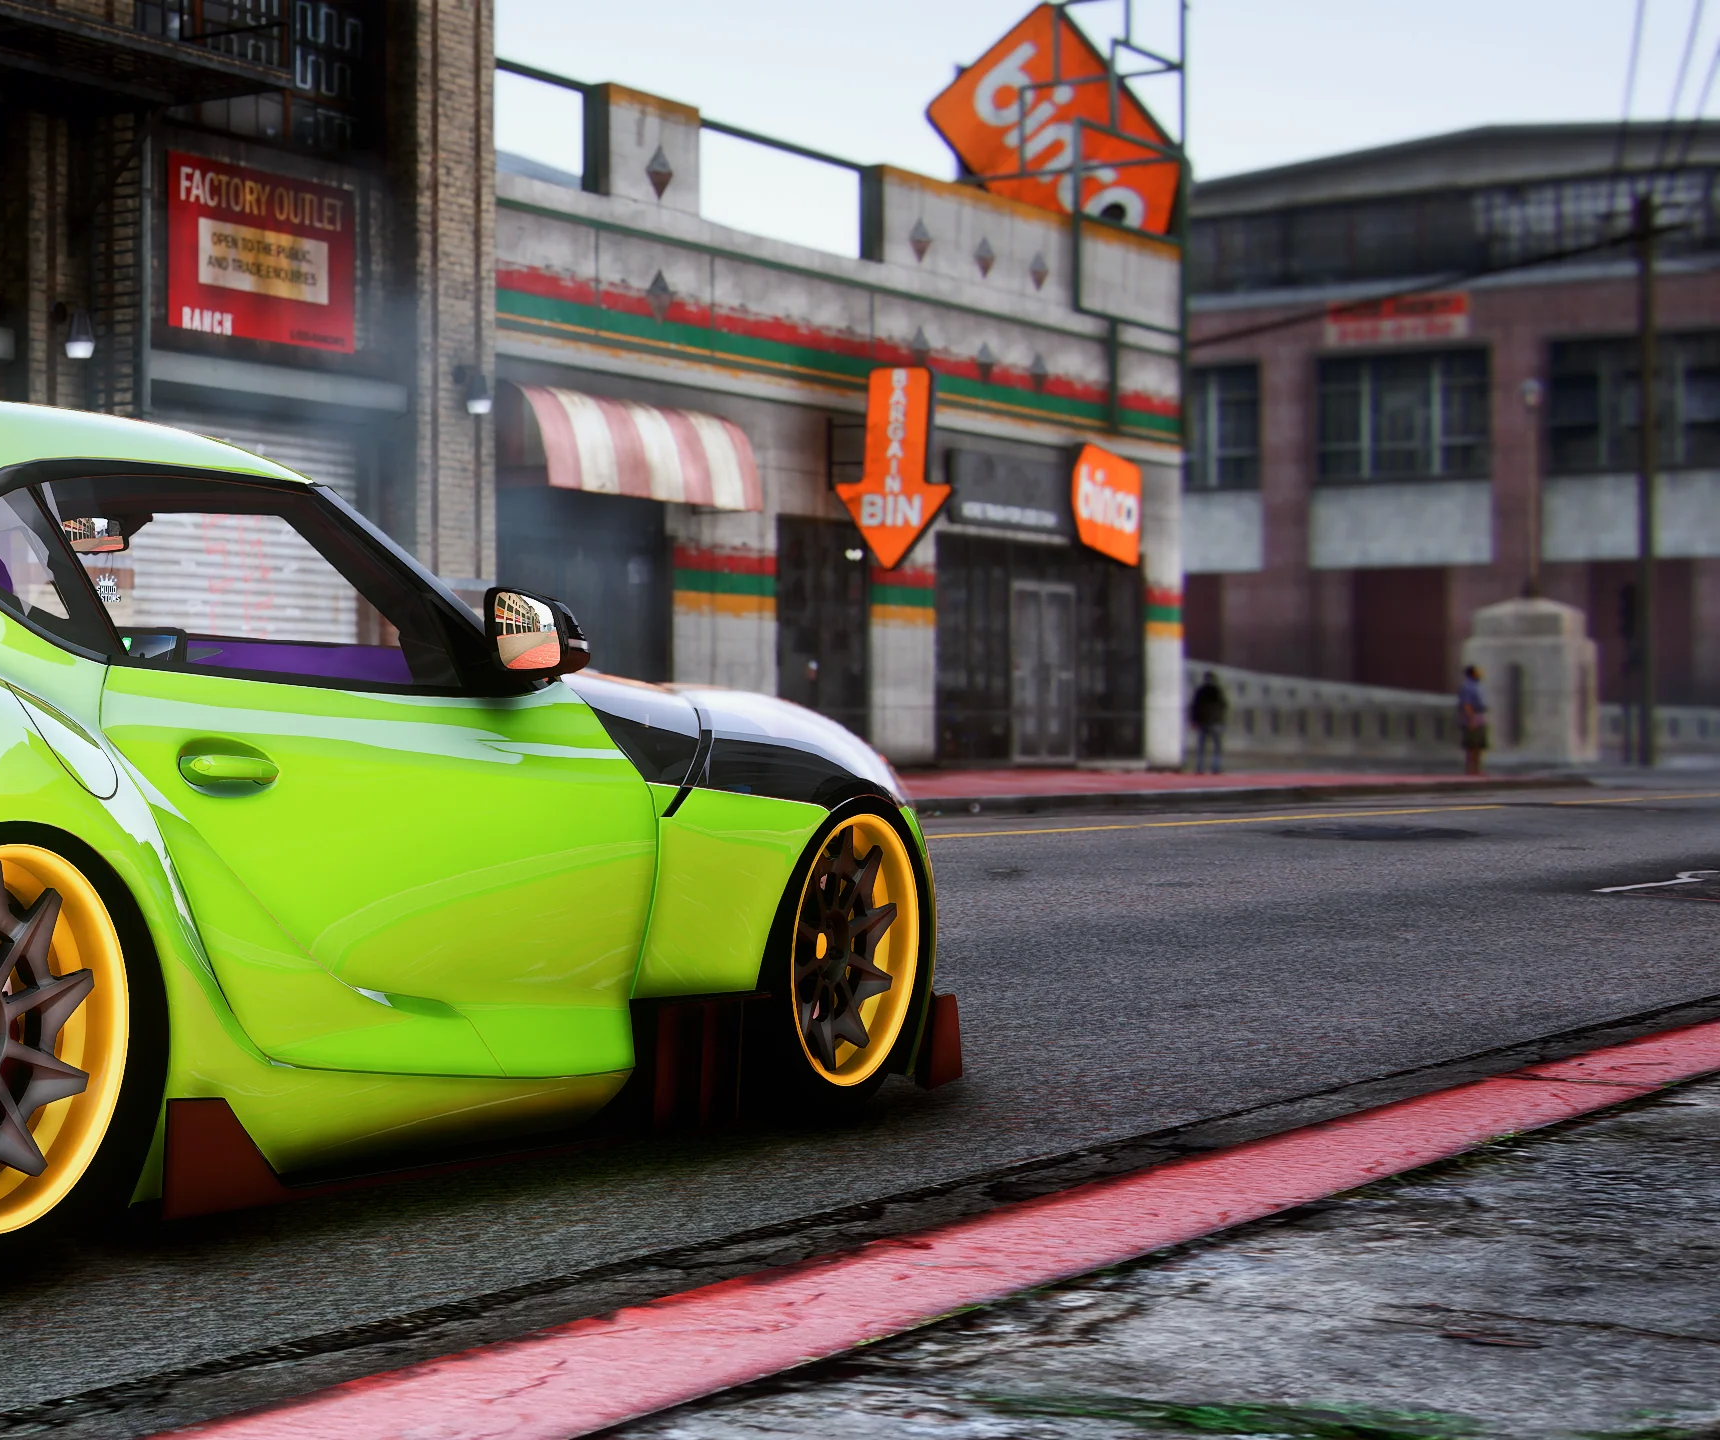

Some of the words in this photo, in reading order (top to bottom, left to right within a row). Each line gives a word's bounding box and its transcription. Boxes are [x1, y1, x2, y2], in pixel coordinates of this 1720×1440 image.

[974, 41, 1146, 228] binco
[180, 166, 271, 217] FACTORY
[274, 186, 344, 232] OUTLET
[206, 254, 230, 271] AND
[231, 258, 263, 278] TRADE
[211, 232, 238, 250] OPEN
[241, 237, 255, 252] TO
[255, 240, 273, 256] THE
[181, 306, 233, 336] RANCH
[884, 368, 908, 494] BARGAIN
[860, 493, 922, 527] BIN
[1078, 463, 1140, 534] binco
